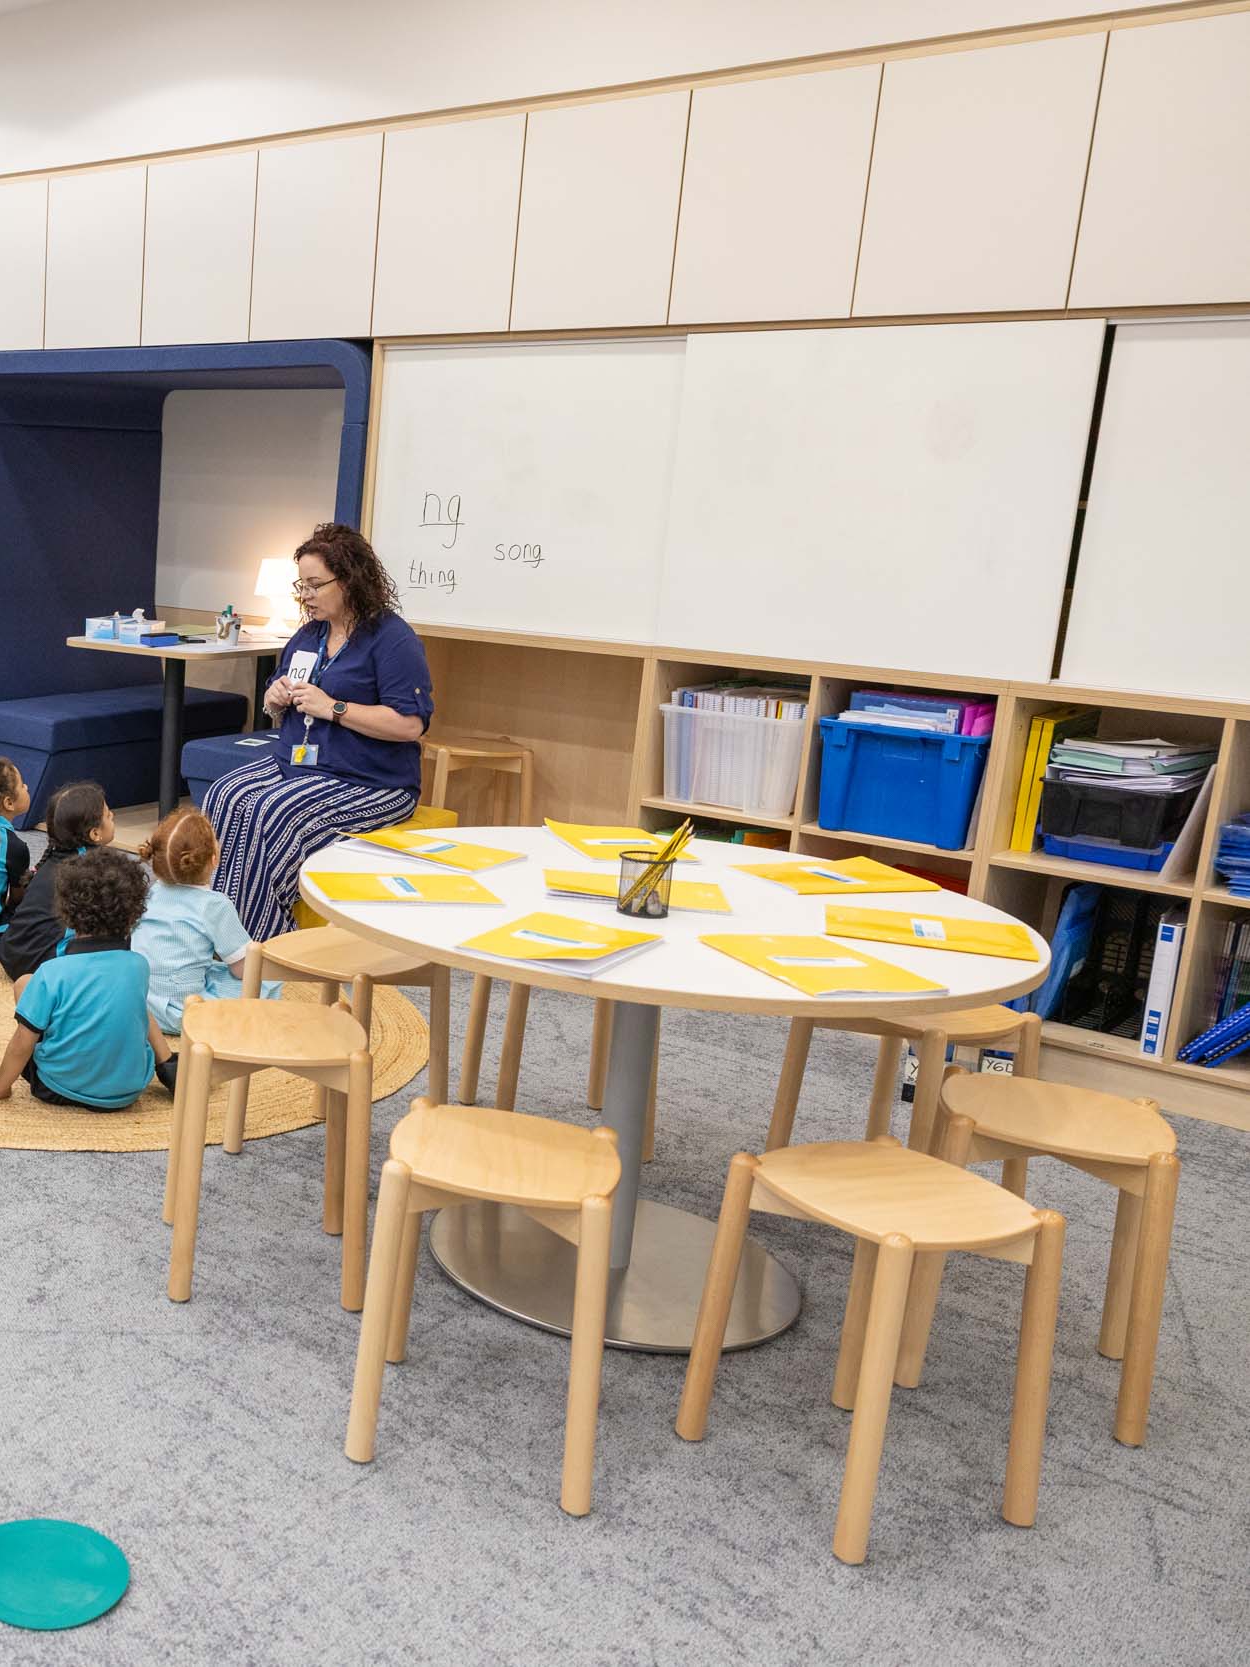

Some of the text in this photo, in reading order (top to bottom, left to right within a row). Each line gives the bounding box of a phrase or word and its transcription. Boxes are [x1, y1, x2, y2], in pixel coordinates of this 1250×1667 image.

[422, 490, 463, 549] ng
[494, 543, 543, 569] song
[408, 559, 456, 594] thing
